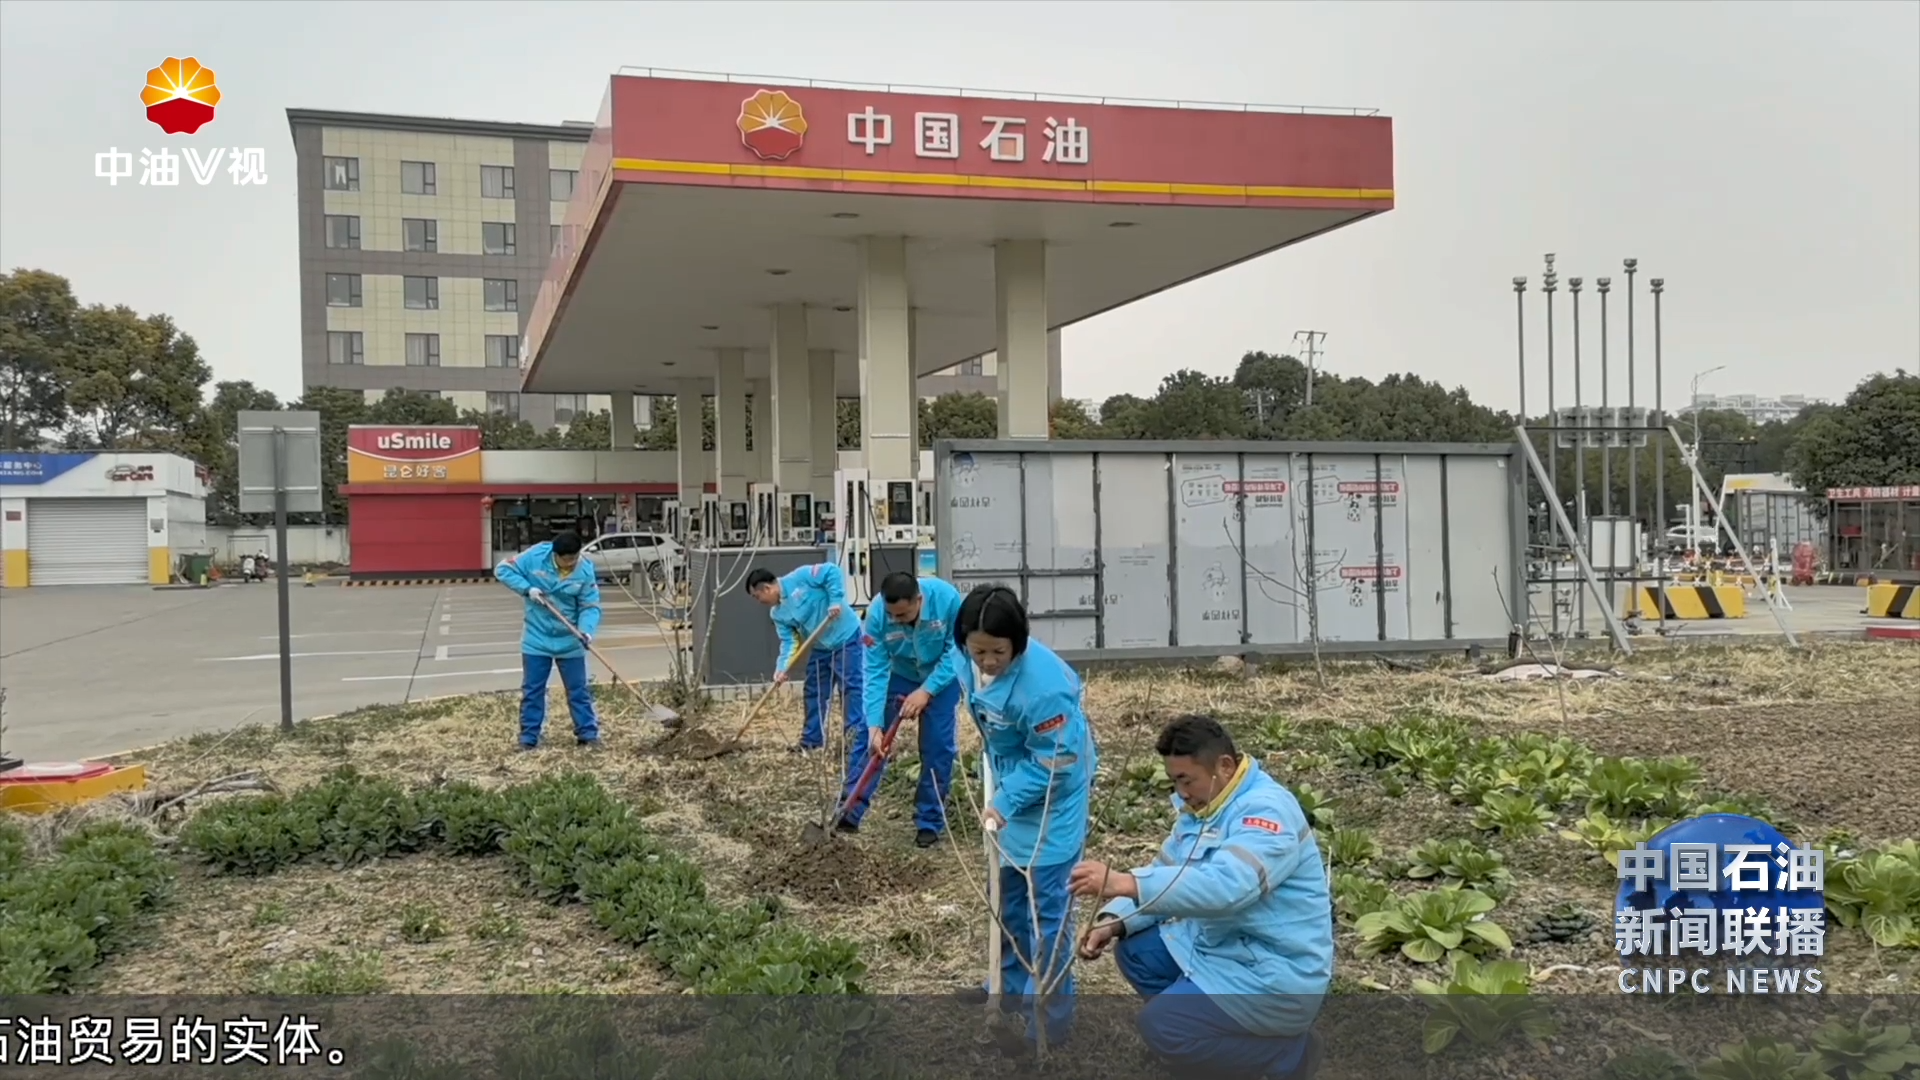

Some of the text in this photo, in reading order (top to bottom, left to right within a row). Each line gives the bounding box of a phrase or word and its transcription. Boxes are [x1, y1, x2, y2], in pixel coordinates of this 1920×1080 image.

[847, 106, 1089, 164] 中国石油
[378, 433, 451, 449] uSmile
[384, 465, 447, 478] 昆仑好客
[1828, 487, 1860, 498] 卫生工具
